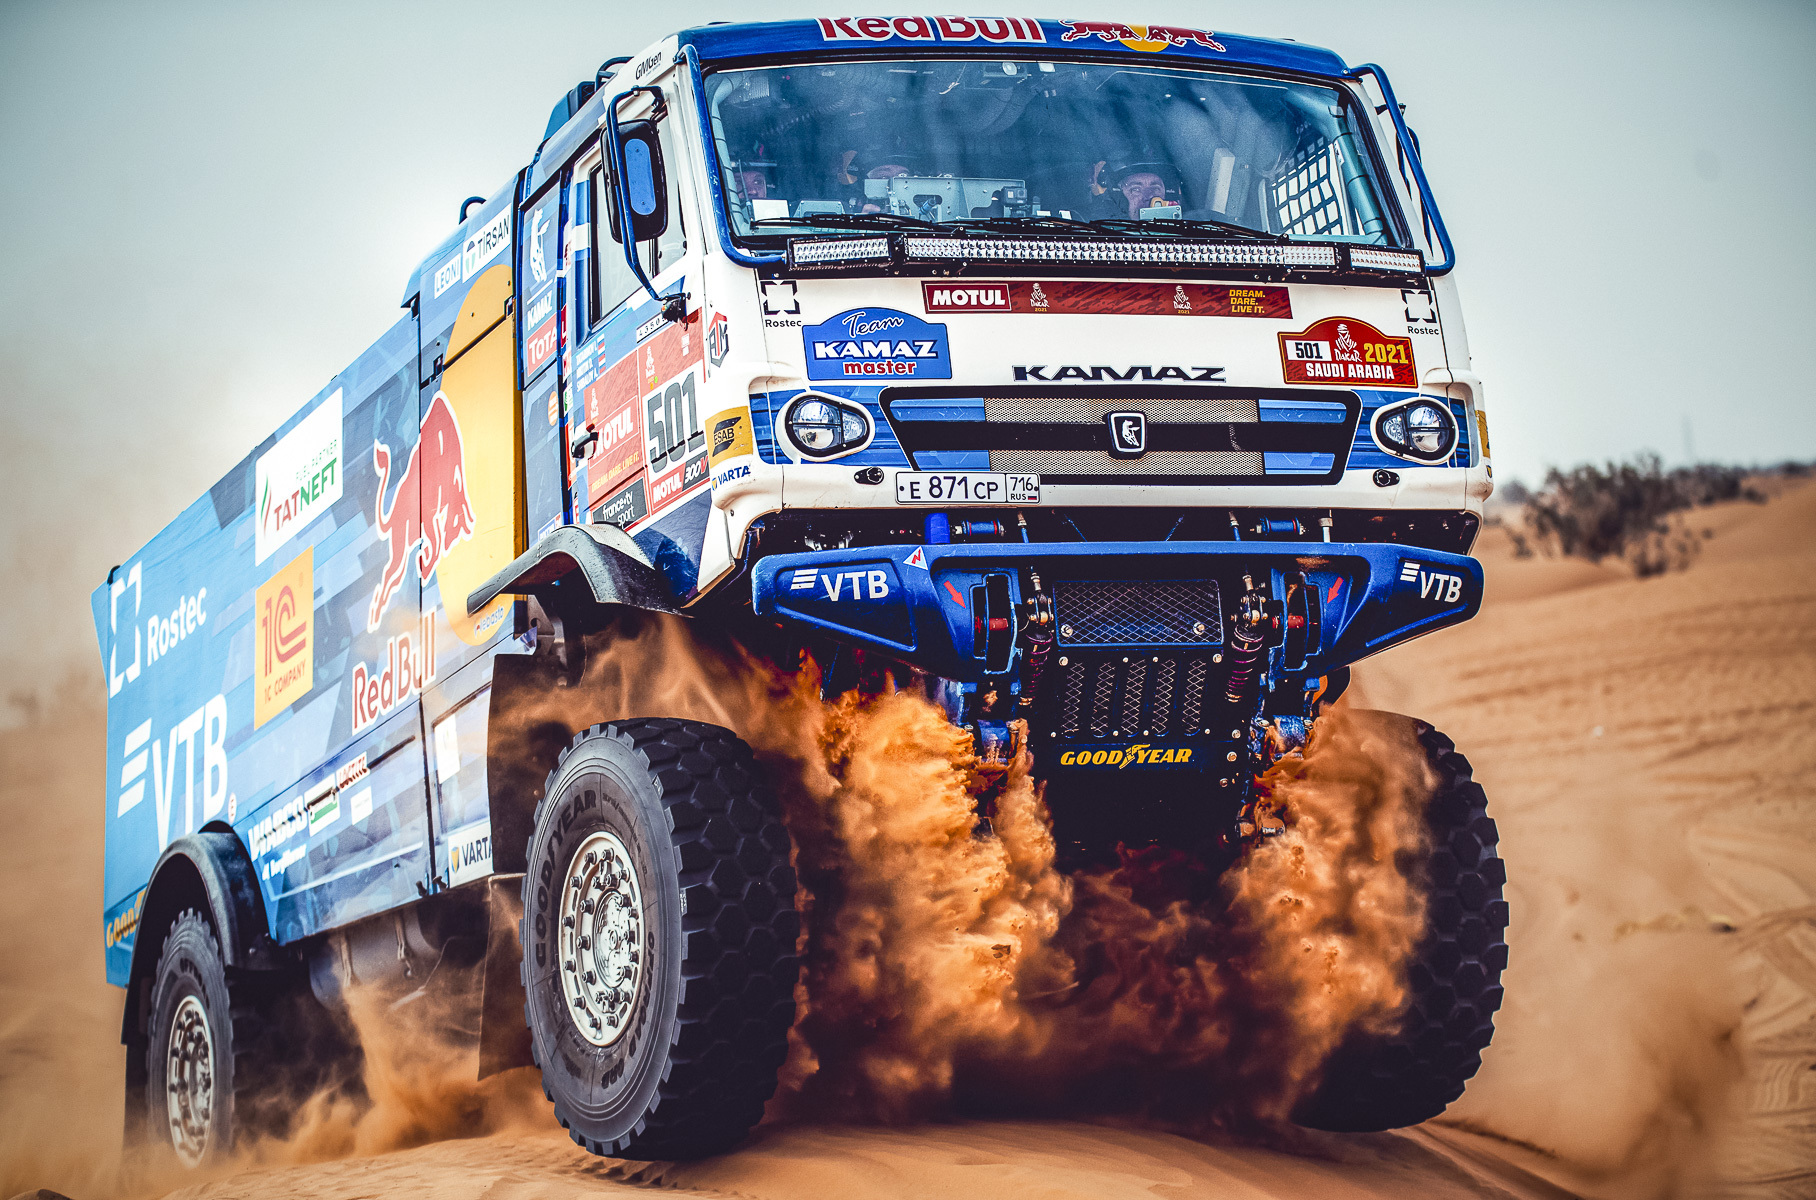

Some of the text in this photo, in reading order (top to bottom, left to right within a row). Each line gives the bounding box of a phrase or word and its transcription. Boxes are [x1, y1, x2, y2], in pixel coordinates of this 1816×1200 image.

[436, 263, 460, 291] LEONI
[932, 290, 1006, 306] MOTUL
[1229, 289, 1266, 298] DREAM.
[1230, 297, 1259, 305] DARE.
[527, 290, 553, 331] KAMAZ
[1232, 305, 1265, 313] LIVE IT.
[765, 319, 802, 328] Rostec
[843, 311, 904, 338] Team
[1407, 326, 1440, 335] Rostec
[813, 340, 939, 360] KAMAZ
[1294, 342, 1409, 364] 501 2021
[844, 361, 916, 374] master
[1012, 365, 1227, 383] KAMAZ
[1306, 362, 1395, 380] SAUDI ARABIA
[593, 408, 634, 459] MOTUL
[648, 371, 706, 474] 501
[713, 427, 735, 446] ESAB
[653, 454, 709, 504] MOTUL 300V
[718, 465, 752, 485] VARTA
[273, 457, 338, 532] TATNEFT
[928, 476, 970, 500] 871
[1010, 477, 1034, 491] 716
[1010, 493, 1027, 501] RUS
[820, 570, 890, 602] VTB
[1420, 571, 1463, 603] VTB
[147, 587, 208, 667] Rostec
[274, 660, 307, 698] COMPANY
[353, 610, 437, 730] Red Bull
[1060, 745, 1193, 768] GOODYEAR
[152, 693, 229, 855] VTB
[248, 795, 308, 863] WABCO
[535, 789, 597, 969] GOODYEAR
